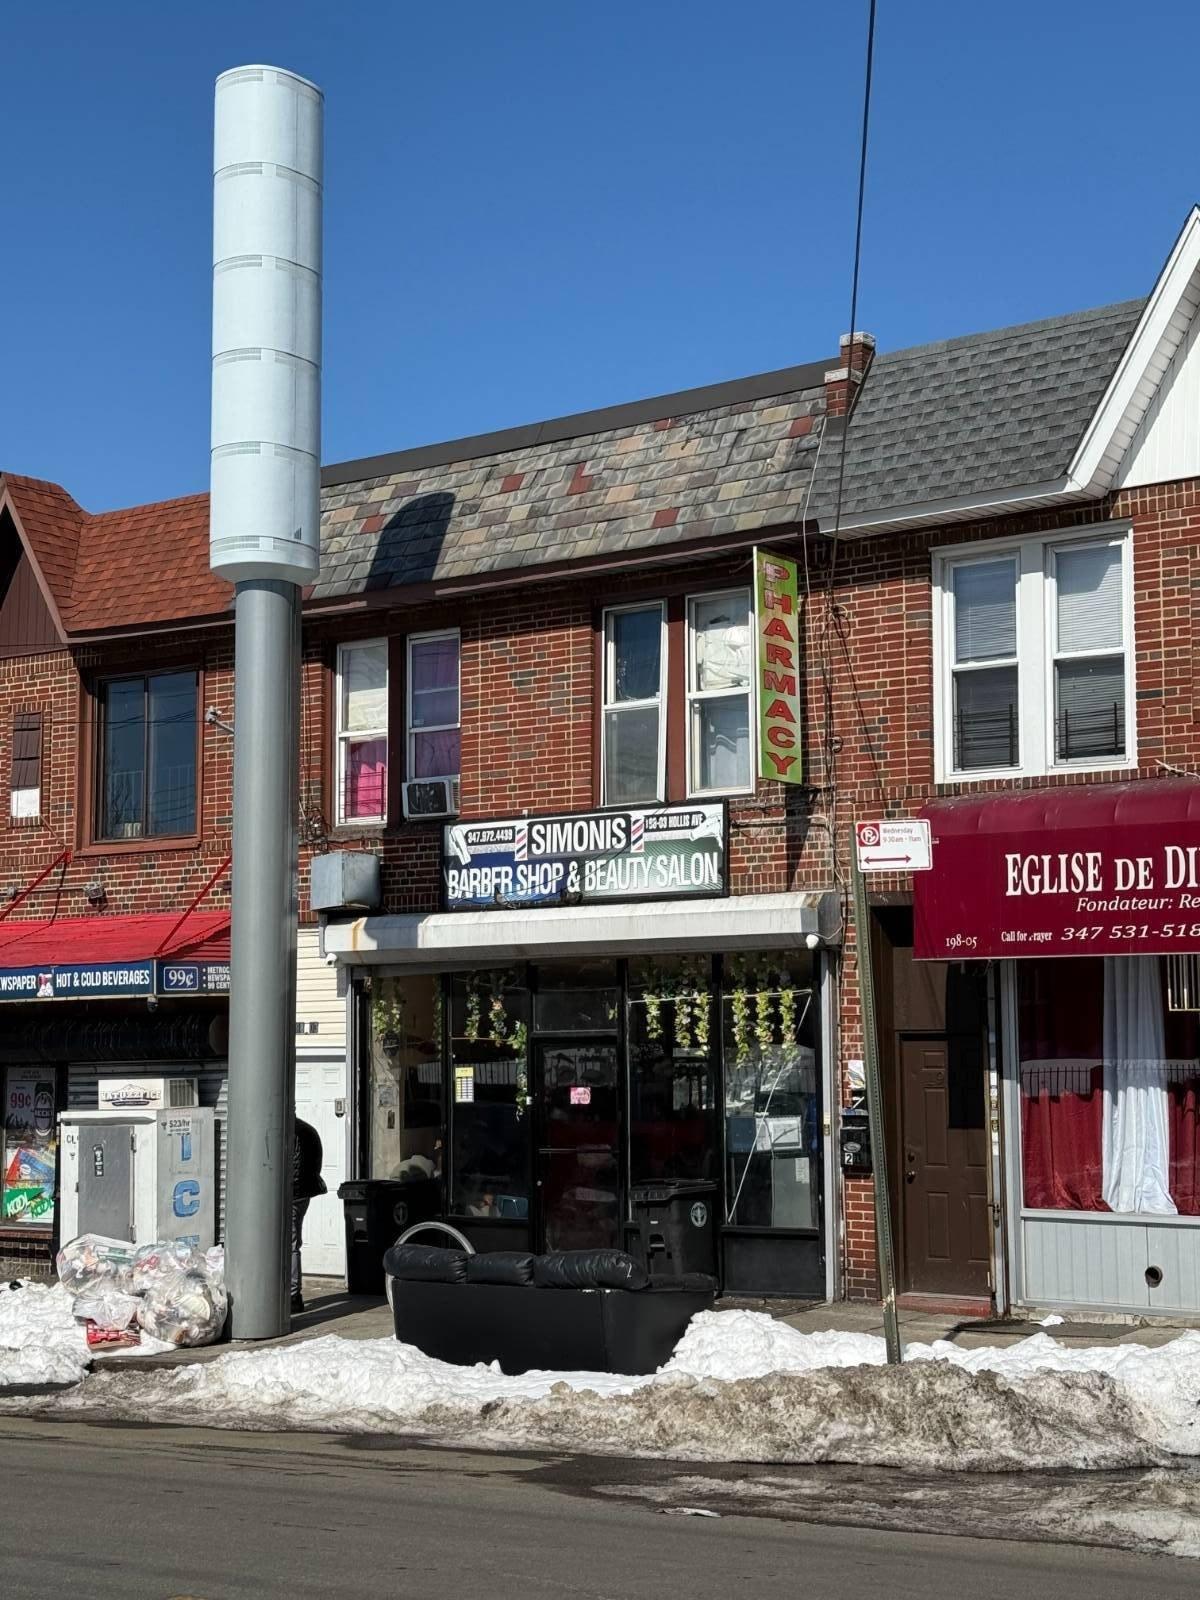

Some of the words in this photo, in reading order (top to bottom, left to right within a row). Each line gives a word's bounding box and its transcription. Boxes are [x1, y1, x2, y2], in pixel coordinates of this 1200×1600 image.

[763, 562, 798, 775] PHARMACY
[531, 818, 627, 854] SIMONIS
[448, 866, 513, 899] BARBER
[516, 863, 564, 895] SHOP
[567, 861, 581, 893] &
[584, 856, 653, 891] BEAUTY
[655, 852, 719, 887] SALON
[1005, 852, 1103, 896] EGLISE
[1114, 858, 1154, 891] DE
[1164, 845, 1200, 889] DI
[1076, 893, 1173, 912] Fondateur:
[945, 933, 978, 949] 198-05
[1001, 931, 1015, 942] Call
[1016, 931, 1028, 942] for
[1061, 926, 1103, 940] 347
[56, 973, 72, 988] HOT
[73, 972, 80, 987] &
[81, 972, 101, 987] COLD
[102, 970, 150, 985] BEVERAGES
[168, 969, 194, 988] 99¢
[846, 1154, 852, 1164] 2
